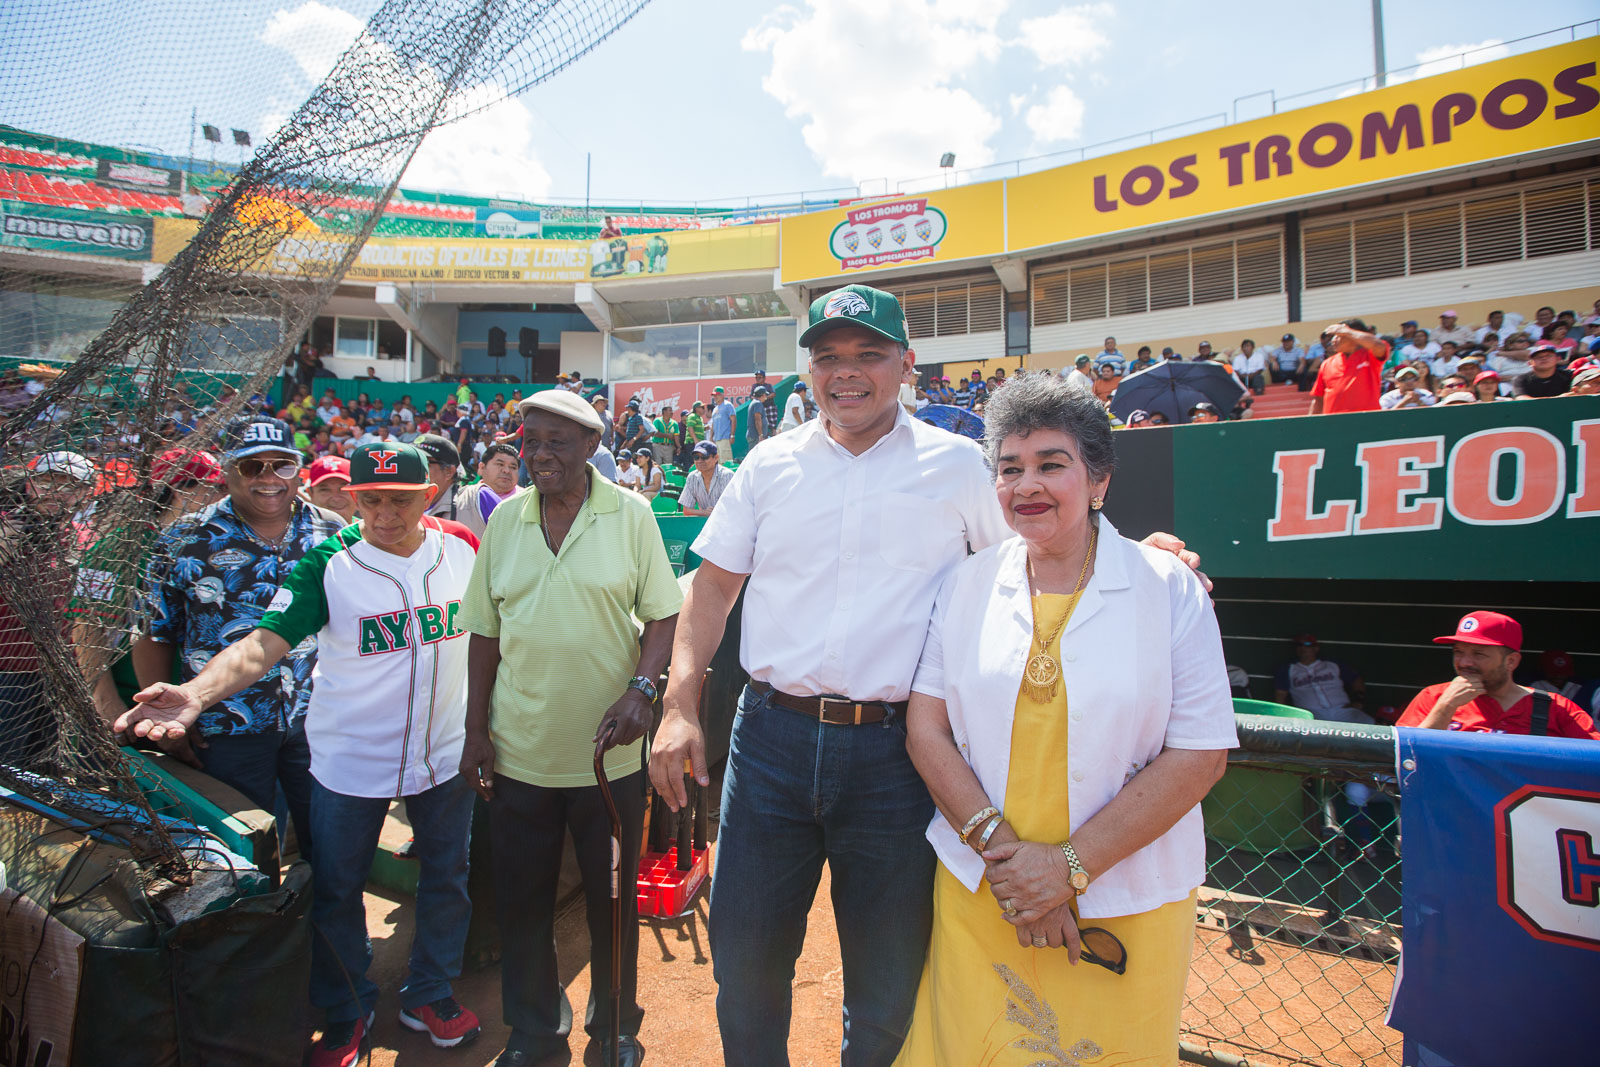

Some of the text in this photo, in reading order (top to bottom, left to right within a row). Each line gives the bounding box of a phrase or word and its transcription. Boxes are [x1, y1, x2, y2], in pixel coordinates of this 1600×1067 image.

[1093, 61, 1600, 213] LOS TROMPOS
[854, 203, 918, 222] LOS TROMPOS
[358, 244, 435, 267] RODUCTOS
[438, 246, 508, 267] OFICIALES
[510, 247, 531, 267] DE
[533, 247, 587, 268] LEONES
[846, 259, 868, 267] TACOS
[876, 248, 930, 263] ESPECIALIDADES
[484, 270, 509, 279] VECTOR
[1238, 721, 1397, 740] eportesguerrero.co
